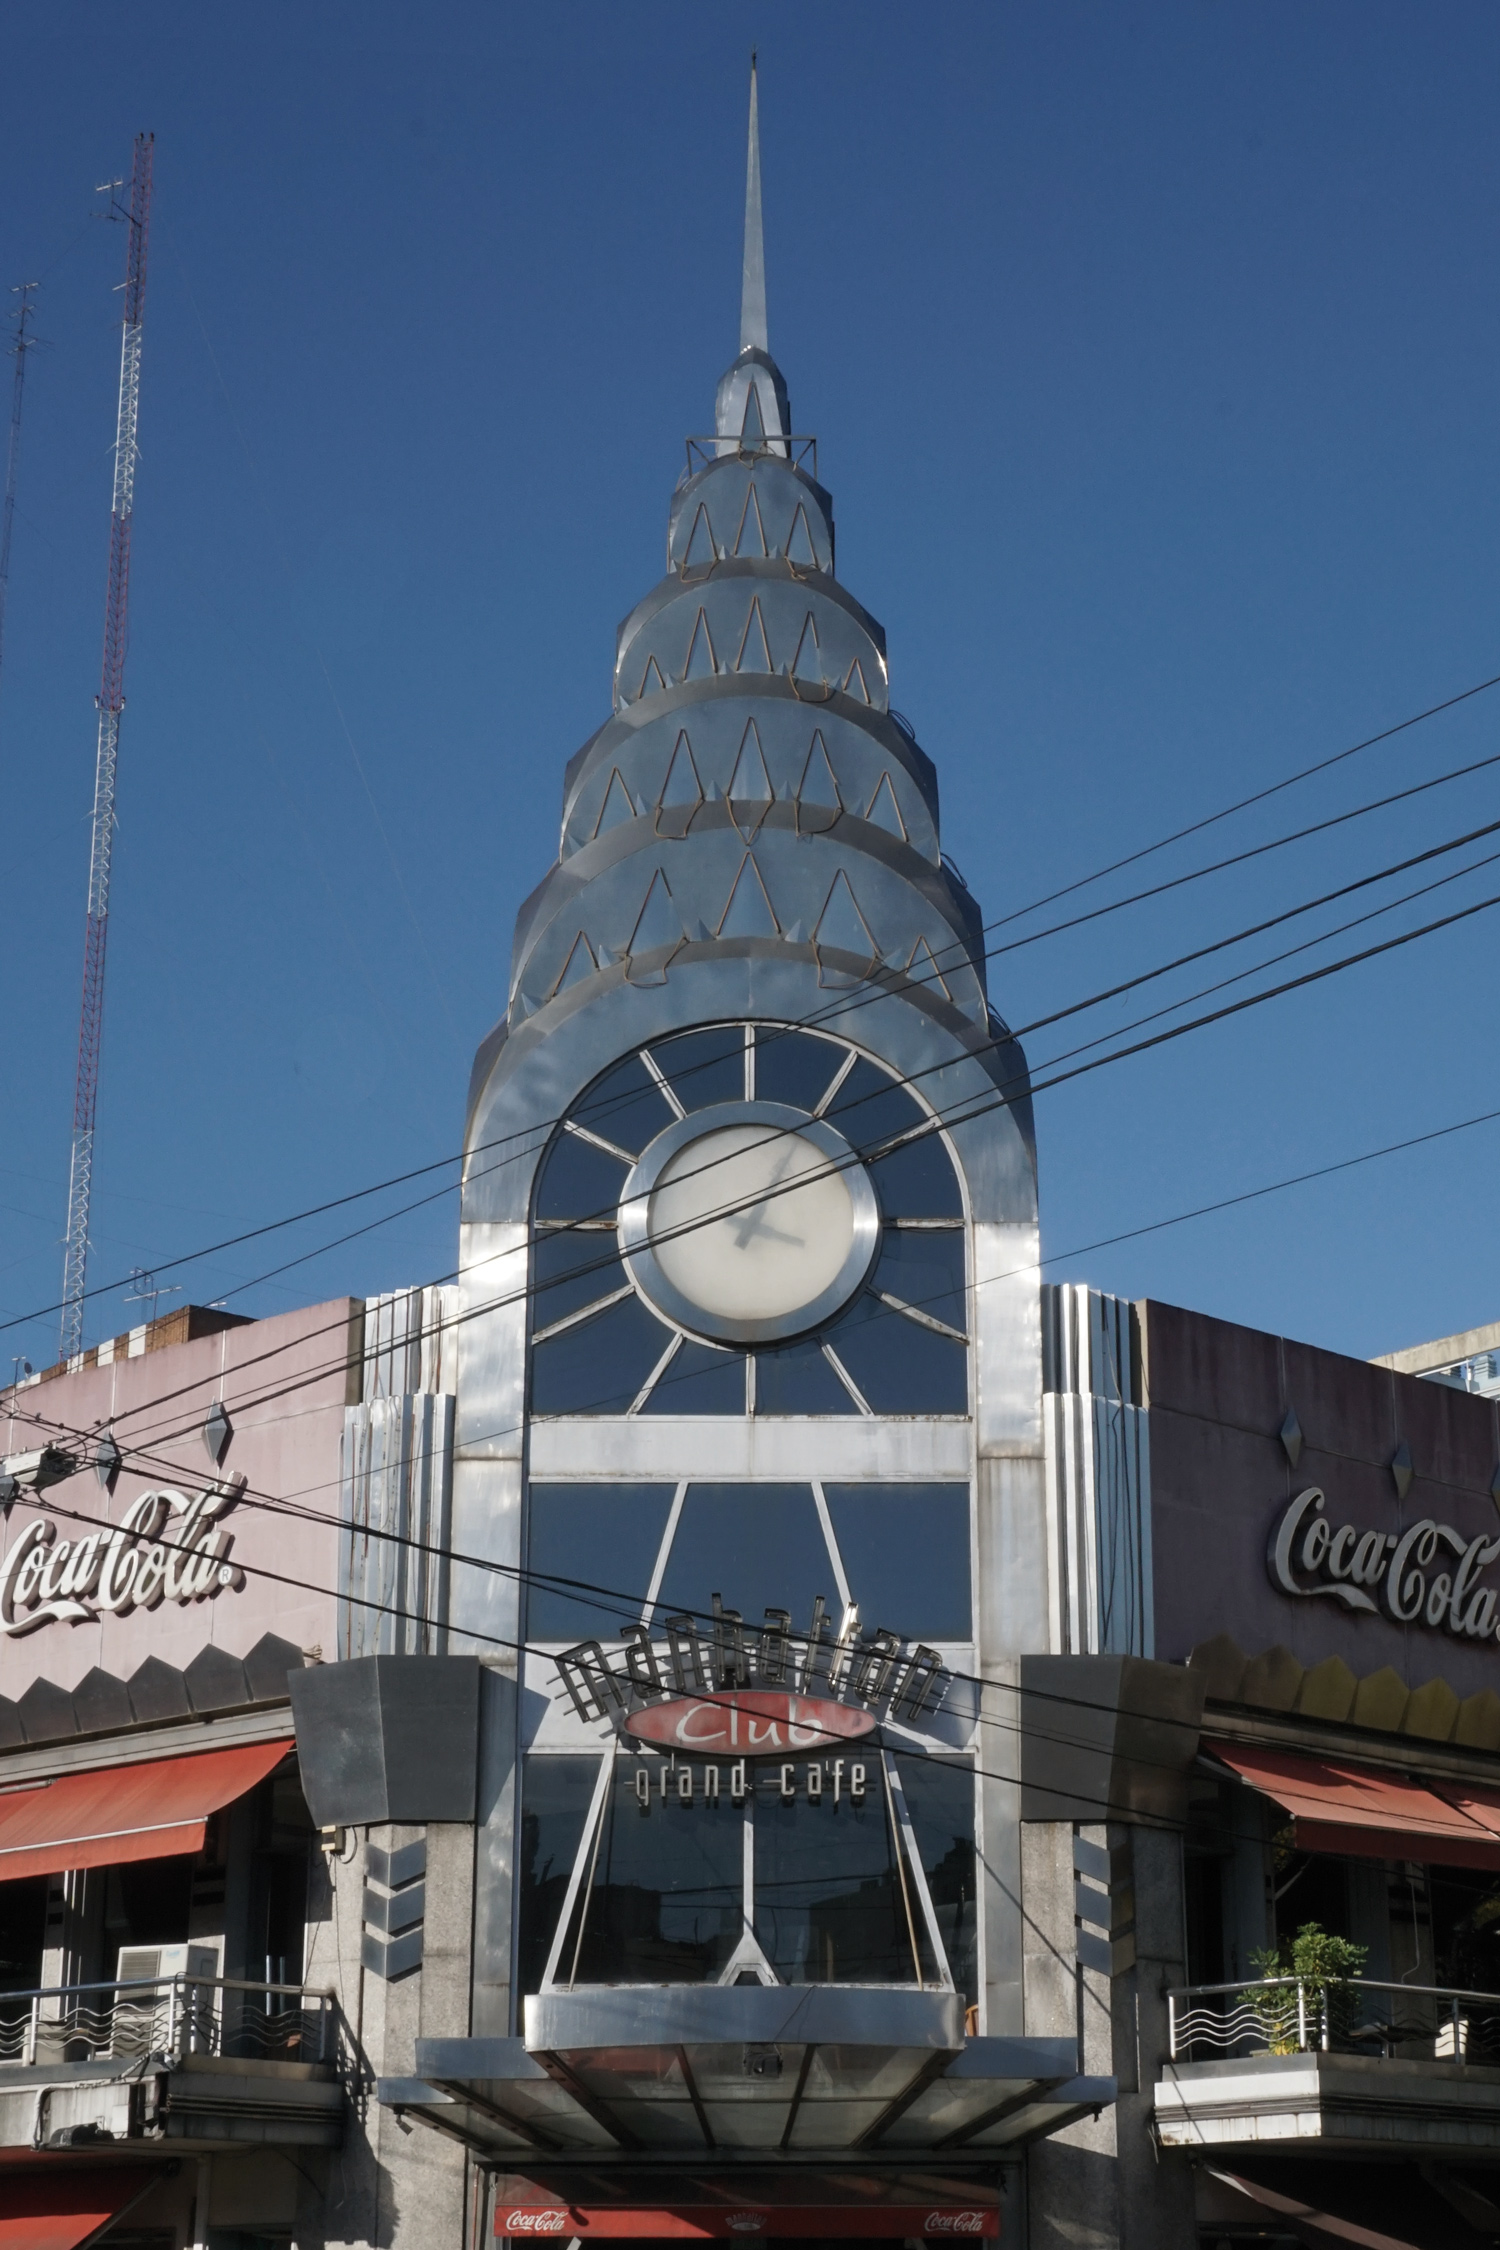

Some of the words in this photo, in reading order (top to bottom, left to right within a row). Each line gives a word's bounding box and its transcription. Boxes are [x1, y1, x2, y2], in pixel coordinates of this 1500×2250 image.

[0, 1471, 242, 1633] Coca-Cola
[1275, 1487, 1500, 1637] Coca-Cola
[676, 1699, 823, 1747] Club
[635, 1758, 746, 1807] grand
[506, 2210, 568, 2231] Coca-Cola
[924, 2211, 987, 2232] Coca-Cola
